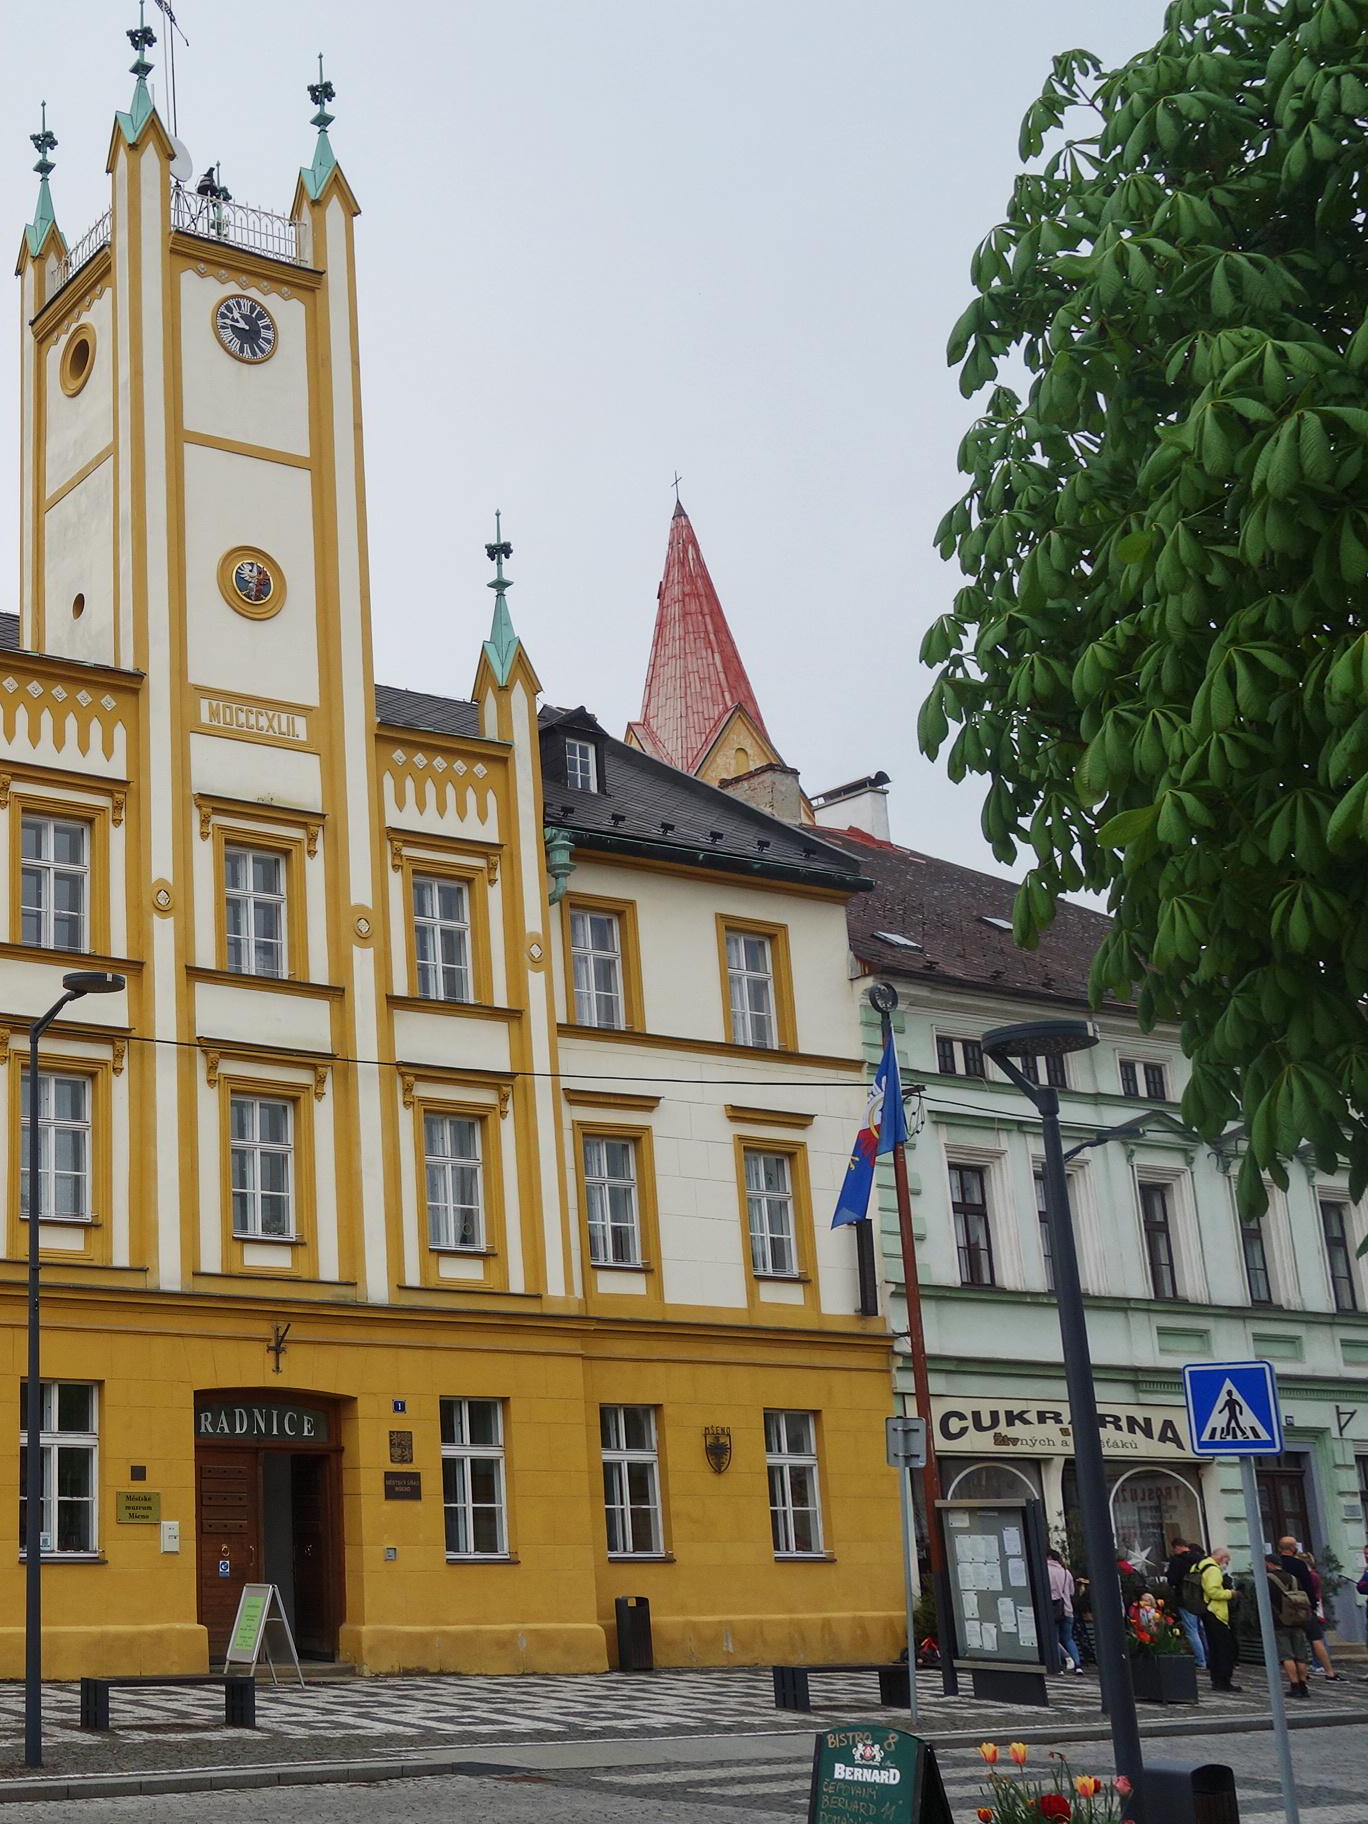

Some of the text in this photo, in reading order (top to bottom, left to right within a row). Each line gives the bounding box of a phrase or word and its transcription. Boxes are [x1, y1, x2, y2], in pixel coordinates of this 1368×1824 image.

[200, 1408, 315, 1437] RADNICE
[705, 1424, 731, 1435] MŠENO
[939, 1410, 1186, 1451] CUKRRNA
[1061, 1439, 1070, 1447] a
[125, 1494, 153, 1502] Městské
[128, 1512, 150, 1520] Mšeno
[827, 1731, 873, 1749] BISTRO
[834, 1762, 901, 1785] BERNARD
